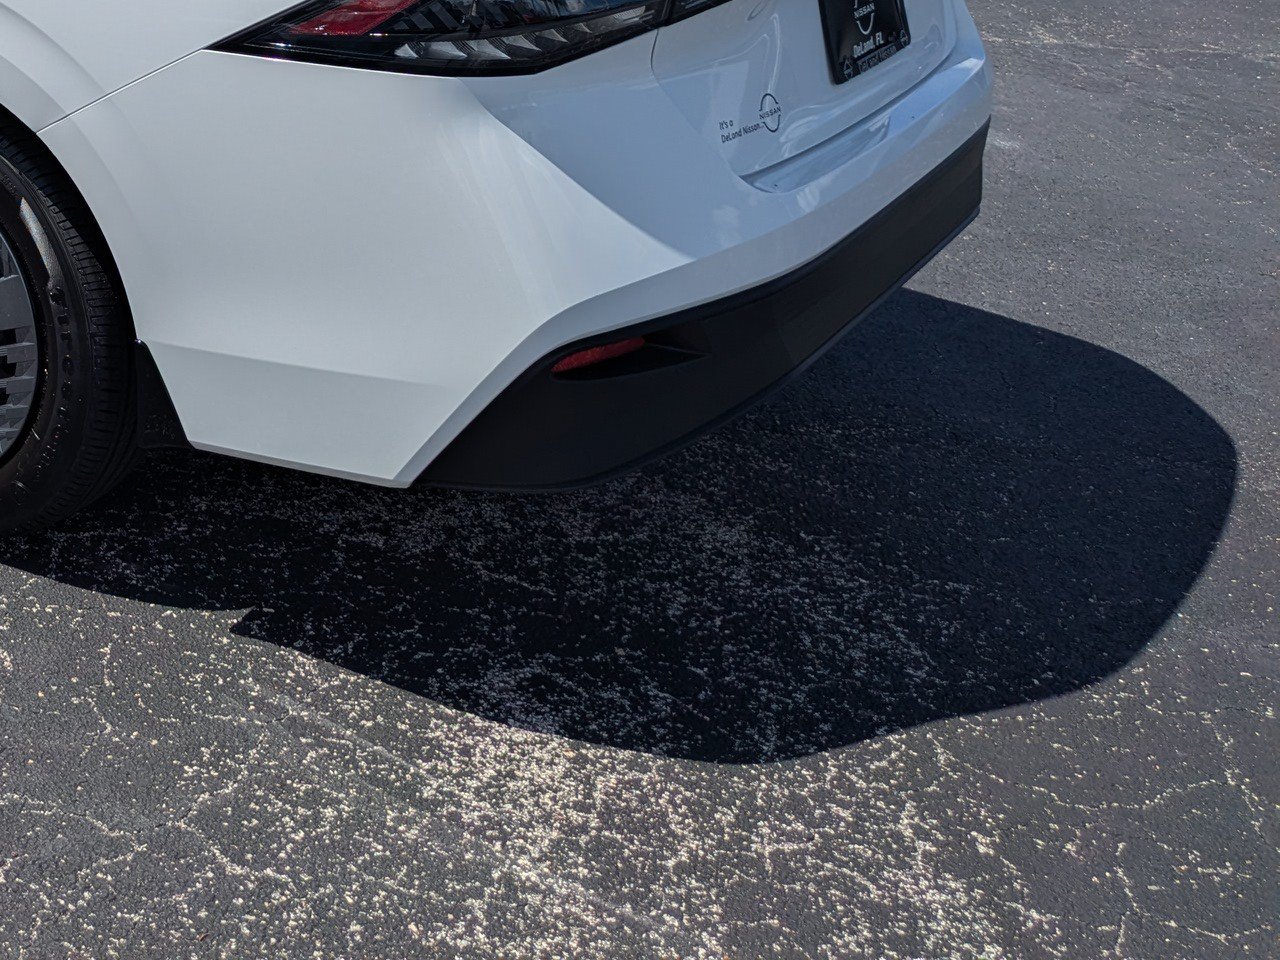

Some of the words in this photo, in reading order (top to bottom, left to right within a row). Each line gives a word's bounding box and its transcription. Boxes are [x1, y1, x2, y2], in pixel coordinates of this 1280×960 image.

[853, 2, 875, 19] NISSAN
[875, 31, 884, 46] FL
[759, 106, 781, 120] NISSAN
[719, 120, 728, 131] It's
[721, 127, 742, 144] DeLand
